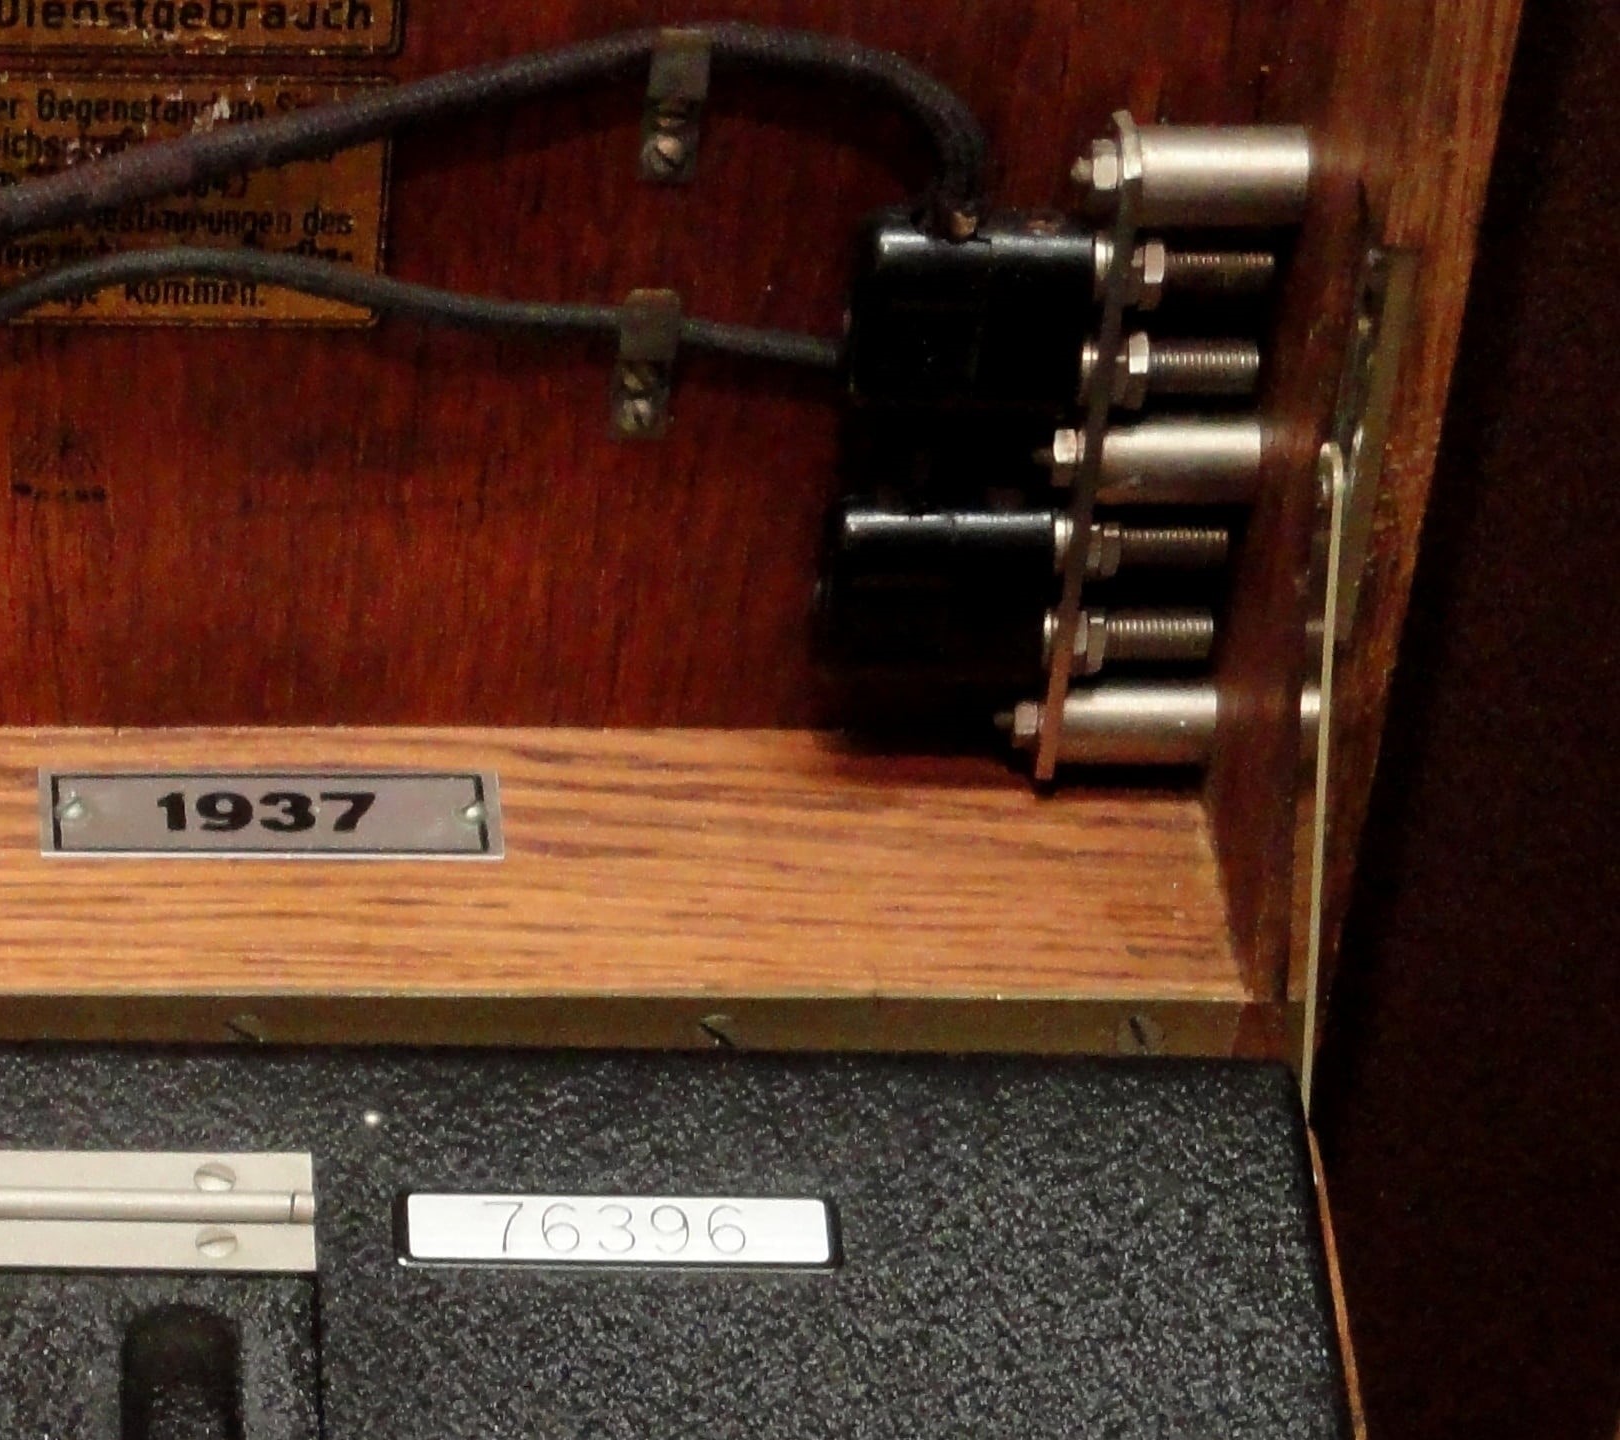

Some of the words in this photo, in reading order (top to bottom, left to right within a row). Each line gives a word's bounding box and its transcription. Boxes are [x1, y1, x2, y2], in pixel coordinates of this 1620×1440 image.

[302, 202, 354, 236] des
[158, 791, 377, 833] 1937
[481, 1201, 746, 1255] 76396
